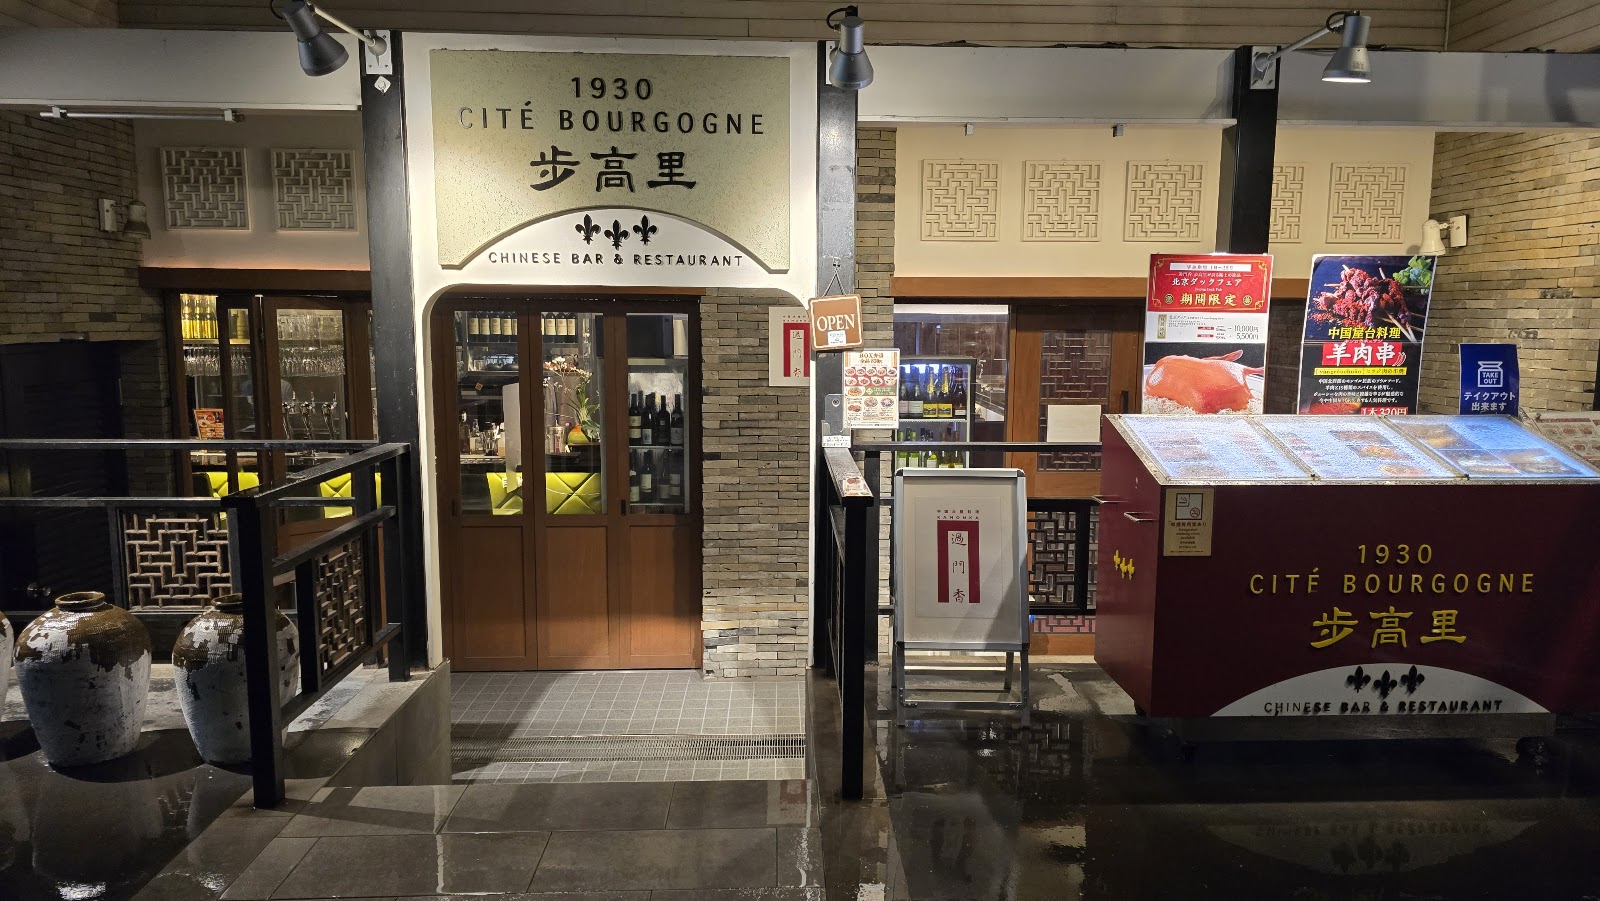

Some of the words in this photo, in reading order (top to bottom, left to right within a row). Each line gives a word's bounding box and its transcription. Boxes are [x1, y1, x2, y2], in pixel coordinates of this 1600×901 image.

[570, 76, 653, 100] 1930
[458, 101, 534, 130] CITÉ
[559, 109, 764, 135] BOURGOGNE
[488, 252, 561, 265] CHINESE
[571, 253, 604, 266] BAR
[613, 253, 624, 266] &
[633, 253, 743, 267] RESTAURANT
[1172, 278, 1242, 286] 北京ダックフェア
[1180, 292, 1238, 306] 期間限定
[816, 314, 856, 332] OPEN
[1328, 326, 1401, 340] 中国屋台料理
[1326, 342, 1396, 366] 羊肉串
[1464, 392, 1516, 401] テイクアウト
[1471, 402, 1506, 411] 出来ます
[1358, 544, 1433, 564] 1930
[951, 532, 967, 604] 過門香
[1250, 567, 1320, 594] CITÉ
[1344, 573, 1535, 594] BOURGOGNE
[1264, 702, 1332, 715] CHINESE
[1340, 701, 1371, 714] BAR
[1380, 700, 1390, 712] &
[1398, 700, 1504, 713] RESTAURANT
